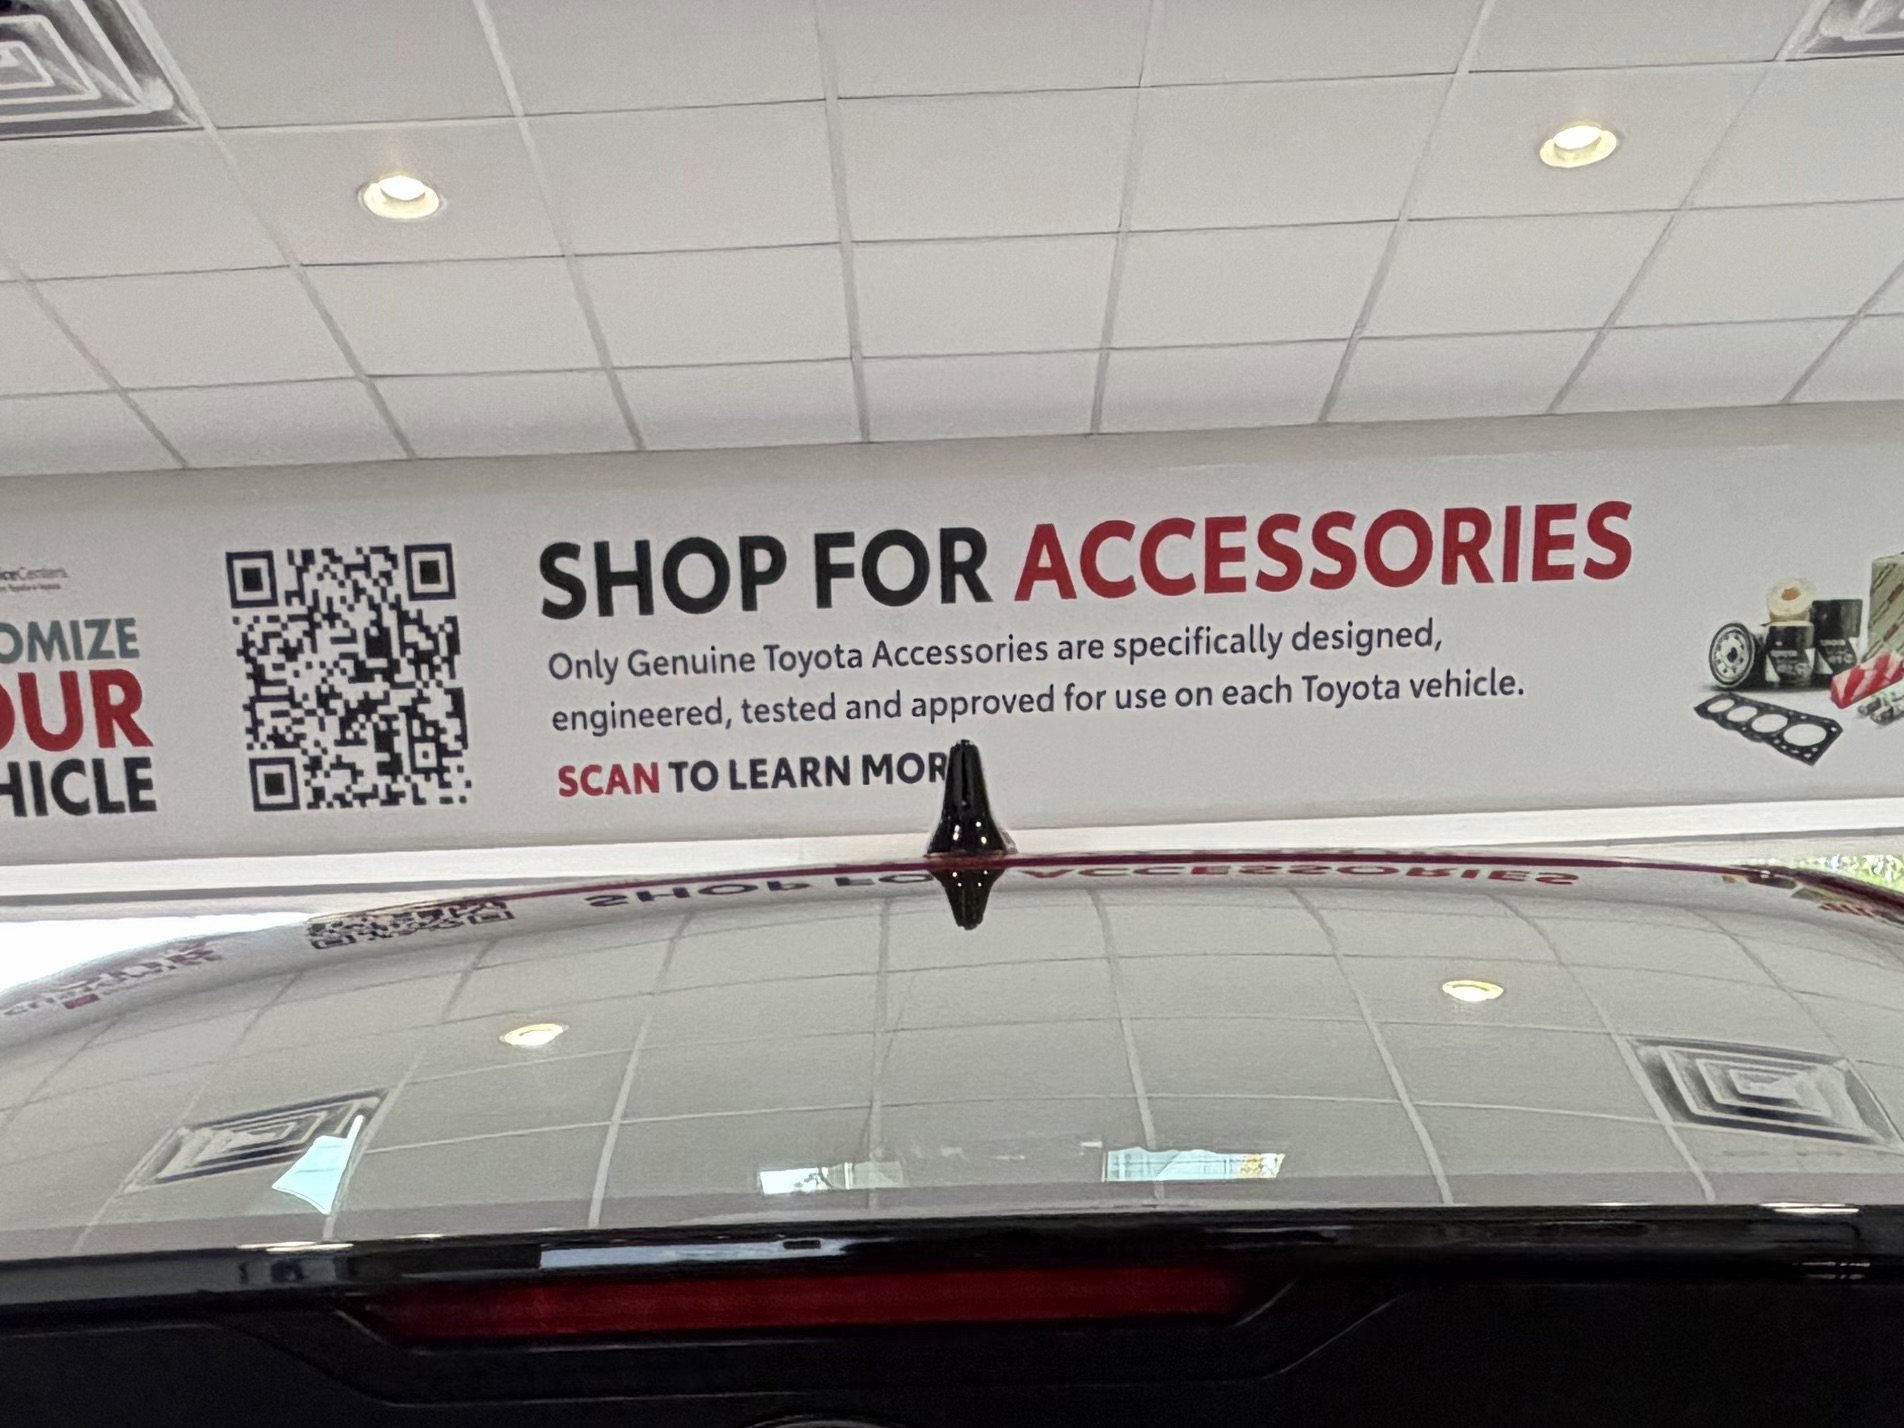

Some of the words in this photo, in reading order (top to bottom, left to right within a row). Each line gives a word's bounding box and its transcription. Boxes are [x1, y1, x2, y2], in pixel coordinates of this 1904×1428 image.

[539, 534, 787, 620] SHOP
[814, 527, 994, 609] FOR
[1013, 500, 1633, 601] ACCESSORIES
[548, 649, 619, 685] Only
[627, 645, 756, 677] Genuine
[763, 641, 863, 678] Toyota
[871, 633, 1049, 668] Accessories
[1057, 637, 1105, 661] are
[1113, 623, 1284, 666] specifically
[1291, 617, 1444, 656] designed,
[552, 696, 733, 737] engineered,
[742, 692, 836, 725] tested
[845, 689, 902, 720] and
[911, 683, 1055, 724] approved
[1064, 682, 1107, 713] for
[1114, 686, 1167, 711] use
[1175, 684, 1213, 709] on
[1222, 675, 1293, 707] each
[1301, 673, 1400, 710] Toyota
[1409, 666, 1526, 701] vehicle.
[557, 761, 660, 798] SCAN
[668, 760, 719, 793] TO
[729, 754, 852, 790] LEARN
[862, 752, 949, 786] MOR
